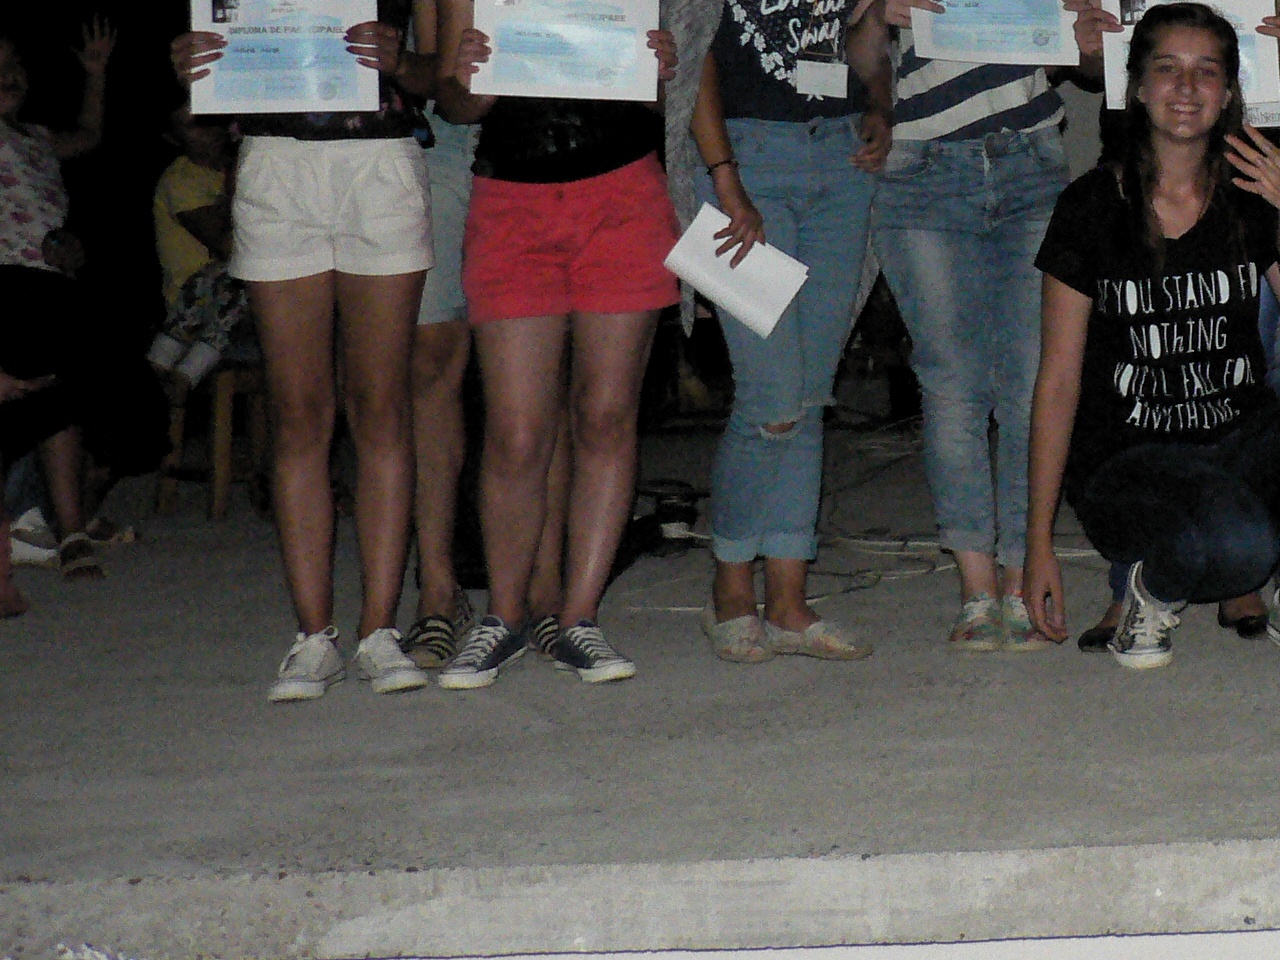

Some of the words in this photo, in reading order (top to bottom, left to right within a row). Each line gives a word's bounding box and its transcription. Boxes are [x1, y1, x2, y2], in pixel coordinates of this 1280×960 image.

[1111, 277, 1156, 316] YOU
[1162, 269, 1231, 312] STAND
[1237, 261, 1259, 300] FO
